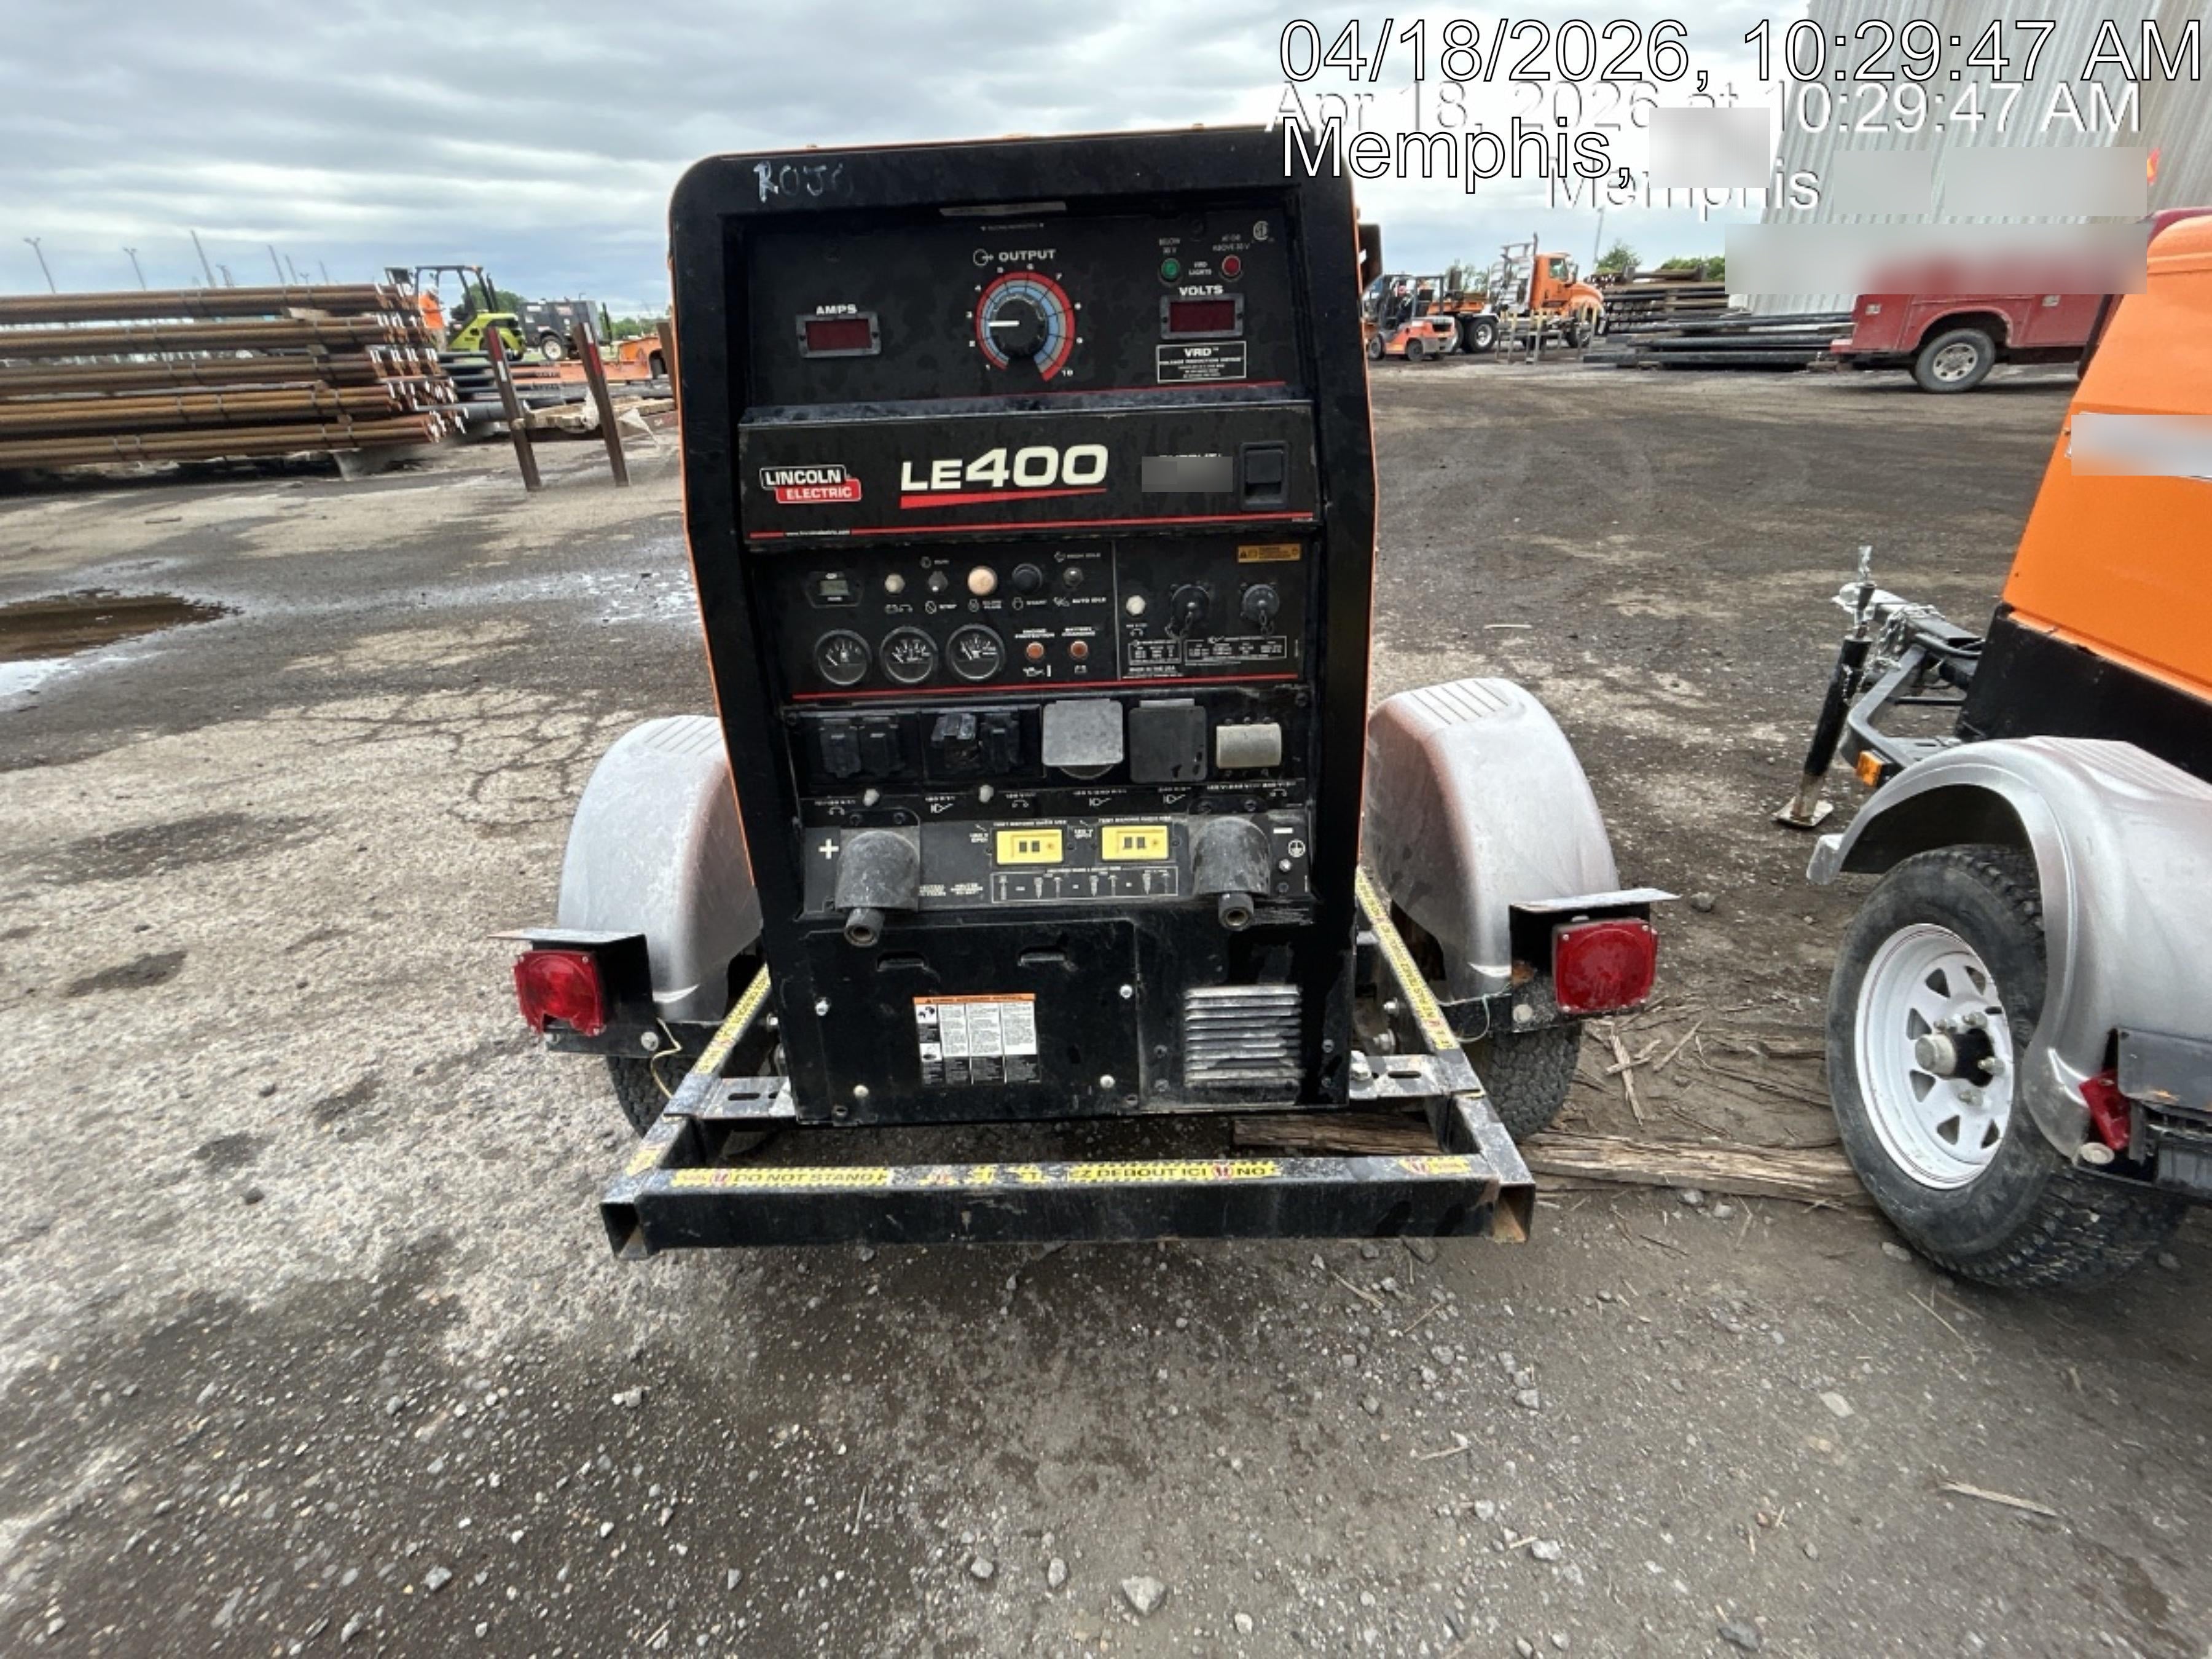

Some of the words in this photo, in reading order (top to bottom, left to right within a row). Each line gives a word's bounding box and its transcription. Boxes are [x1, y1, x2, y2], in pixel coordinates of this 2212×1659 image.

[998, 249, 1056, 262] OUTPUT
[1179, 284, 1224, 296] VOLTS
[815, 304, 858, 316] AMPS
[1061, 369, 1074, 377] 10
[900, 443, 1109, 492] LE400
[764, 469, 842, 486] LINCOLN
[785, 486, 853, 500] ELECTRIC
[734, 1173, 763, 1182] DO
[766, 1172, 809, 1182] NOT
[1097, 1167, 1180, 1177] DEBOUT
[1183, 1167, 1207, 1177] ICI
[1236, 1167, 1266, 1176] NO
